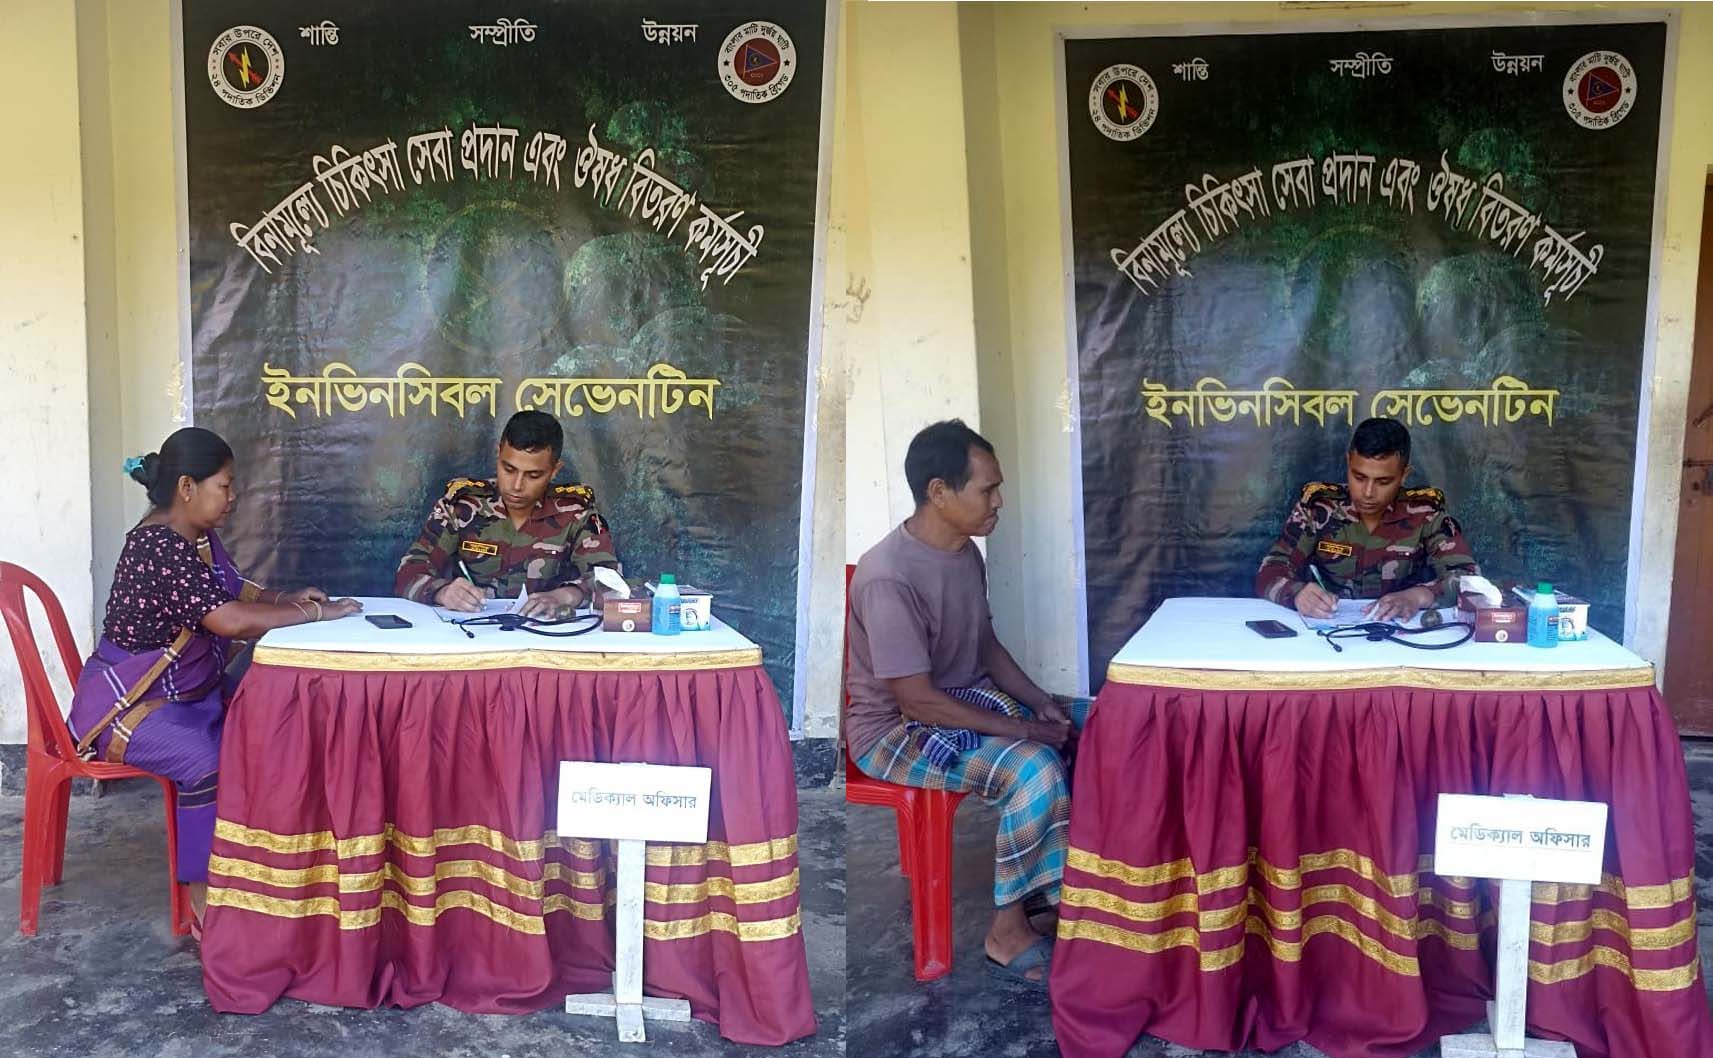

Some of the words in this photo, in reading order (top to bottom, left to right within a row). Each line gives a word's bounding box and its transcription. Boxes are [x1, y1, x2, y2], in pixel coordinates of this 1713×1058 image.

[298, 20, 340, 46] শান্তি
[467, 18, 538, 47] সম্প্রীতি
[641, 17, 699, 46] উন্নয়ন
[1172, 57, 1209, 81] শান্তি
[1329, 52, 1394, 80] সম্প্রীতি
[1491, 49, 1545, 77] উন্নয়ন
[229, 182, 329, 274] বিনামূল্যে
[313, 137, 405, 217] চিকিৎসা
[407, 125, 454, 184] সেবা
[461, 122, 519, 181] প্রদান
[523, 131, 566, 192] এবং
[574, 123, 627, 205] ঔষধ
[618, 148, 697, 239] বিতরণ
[685, 204, 764, 292] কর্মসূচী
[1110, 209, 1200, 296] বিনামূল্যে
[1185, 166, 1270, 242] চিকিৎসা
[1271, 154, 1316, 211] সেবা
[1322, 150, 1376, 205] প্রদান
[1380, 158, 1420, 216] এবং
[1427, 148, 1477, 227] ঔষধ
[1467, 172, 1543, 257] বিতরণ
[1529, 225, 1604, 307] কর্মসূচী
[261, 362, 503, 419] ইনভিনসিবল
[515, 363, 721, 420] সেভেনটিন
[1141, 376, 1359, 429] ইনভিনসিবল
[1370, 375, 1560, 428] সেভেনটিন
[571, 787, 636, 806] মেডিক্যাল
[642, 791, 697, 809] অফিসার
[1450, 823, 1523, 845] মেডিক্যাল
[1530, 827, 1591, 848] অফিসার
